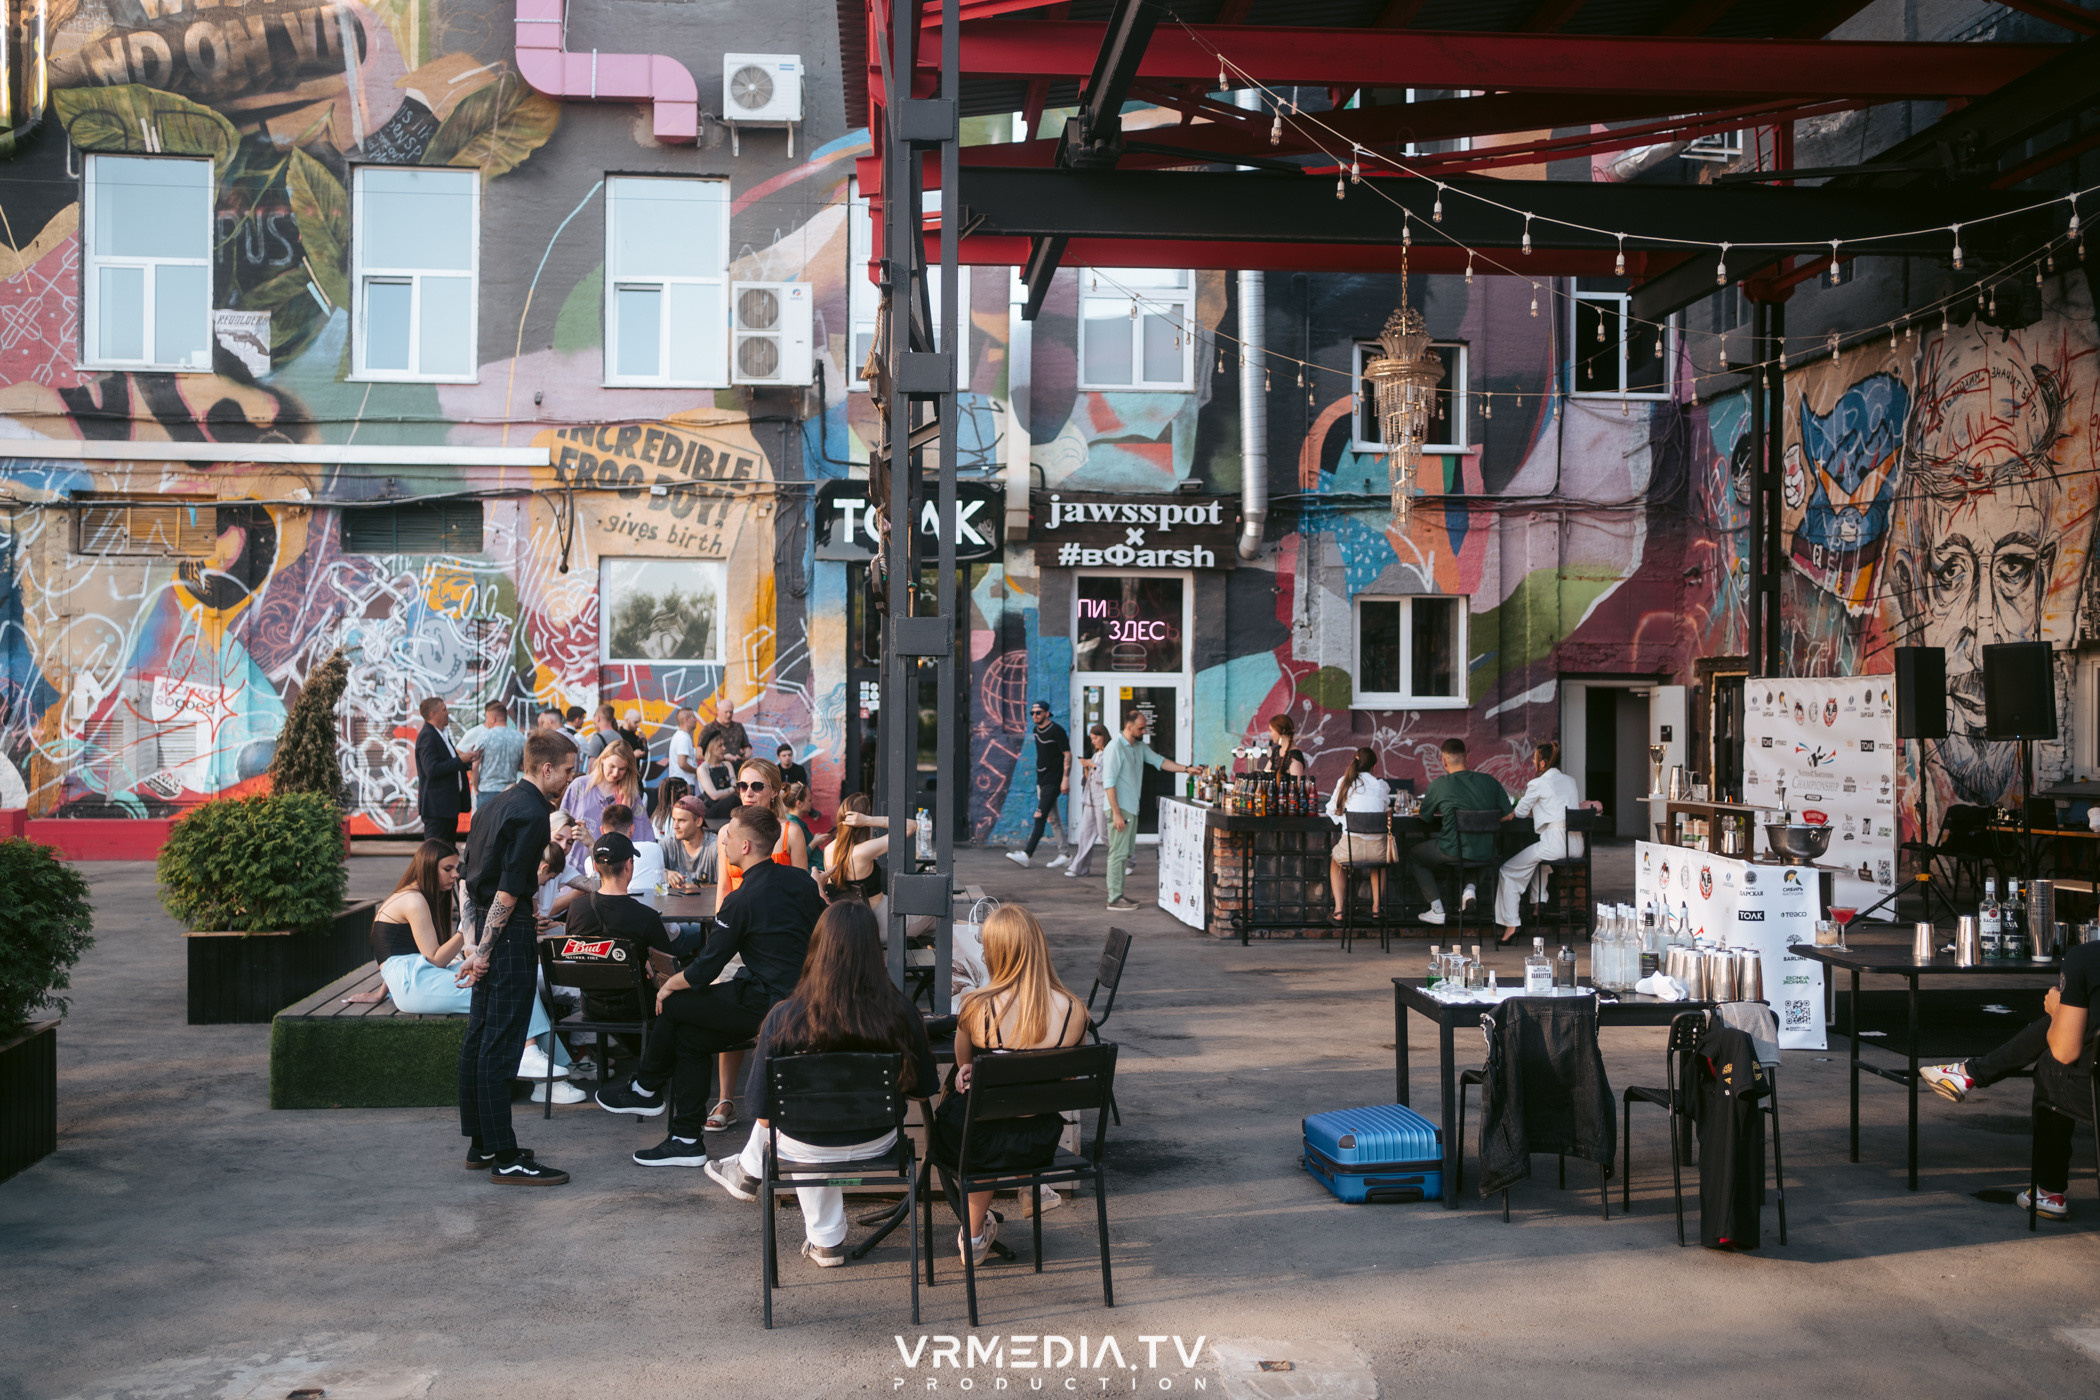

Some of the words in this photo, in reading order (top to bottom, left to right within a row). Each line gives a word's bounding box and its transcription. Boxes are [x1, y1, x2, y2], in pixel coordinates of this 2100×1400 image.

[1044, 494, 1224, 532] jawsspot
[604, 512, 659, 540] gives
[667, 524, 723, 555] birth
[568, 940, 601, 953] Bud
